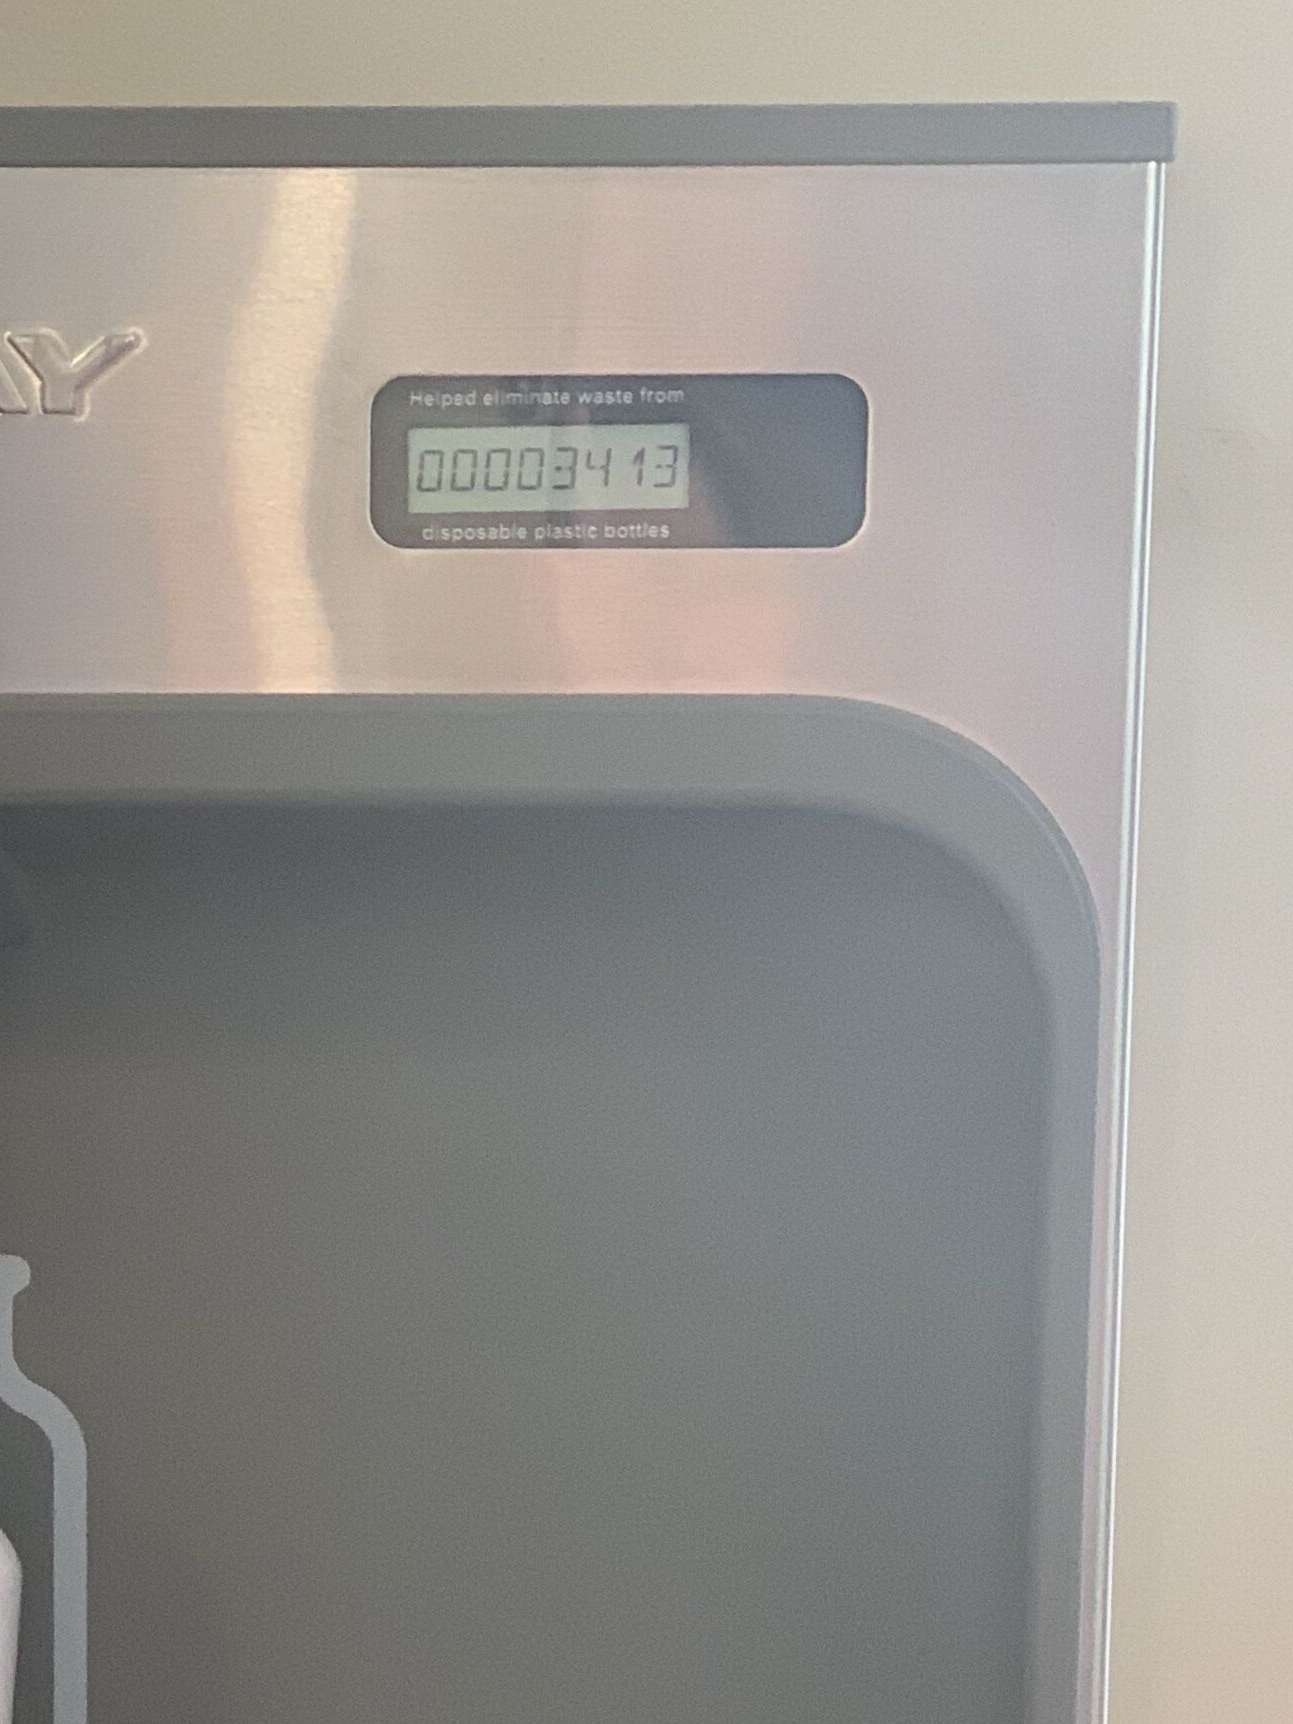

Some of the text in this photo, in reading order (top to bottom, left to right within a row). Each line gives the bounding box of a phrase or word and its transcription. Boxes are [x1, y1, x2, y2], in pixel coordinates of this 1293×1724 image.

[409, 386, 685, 409] Helped eliminate waste from
[416, 444, 678, 492] 00003413
[421, 522, 671, 542] disposable plastic bottles
